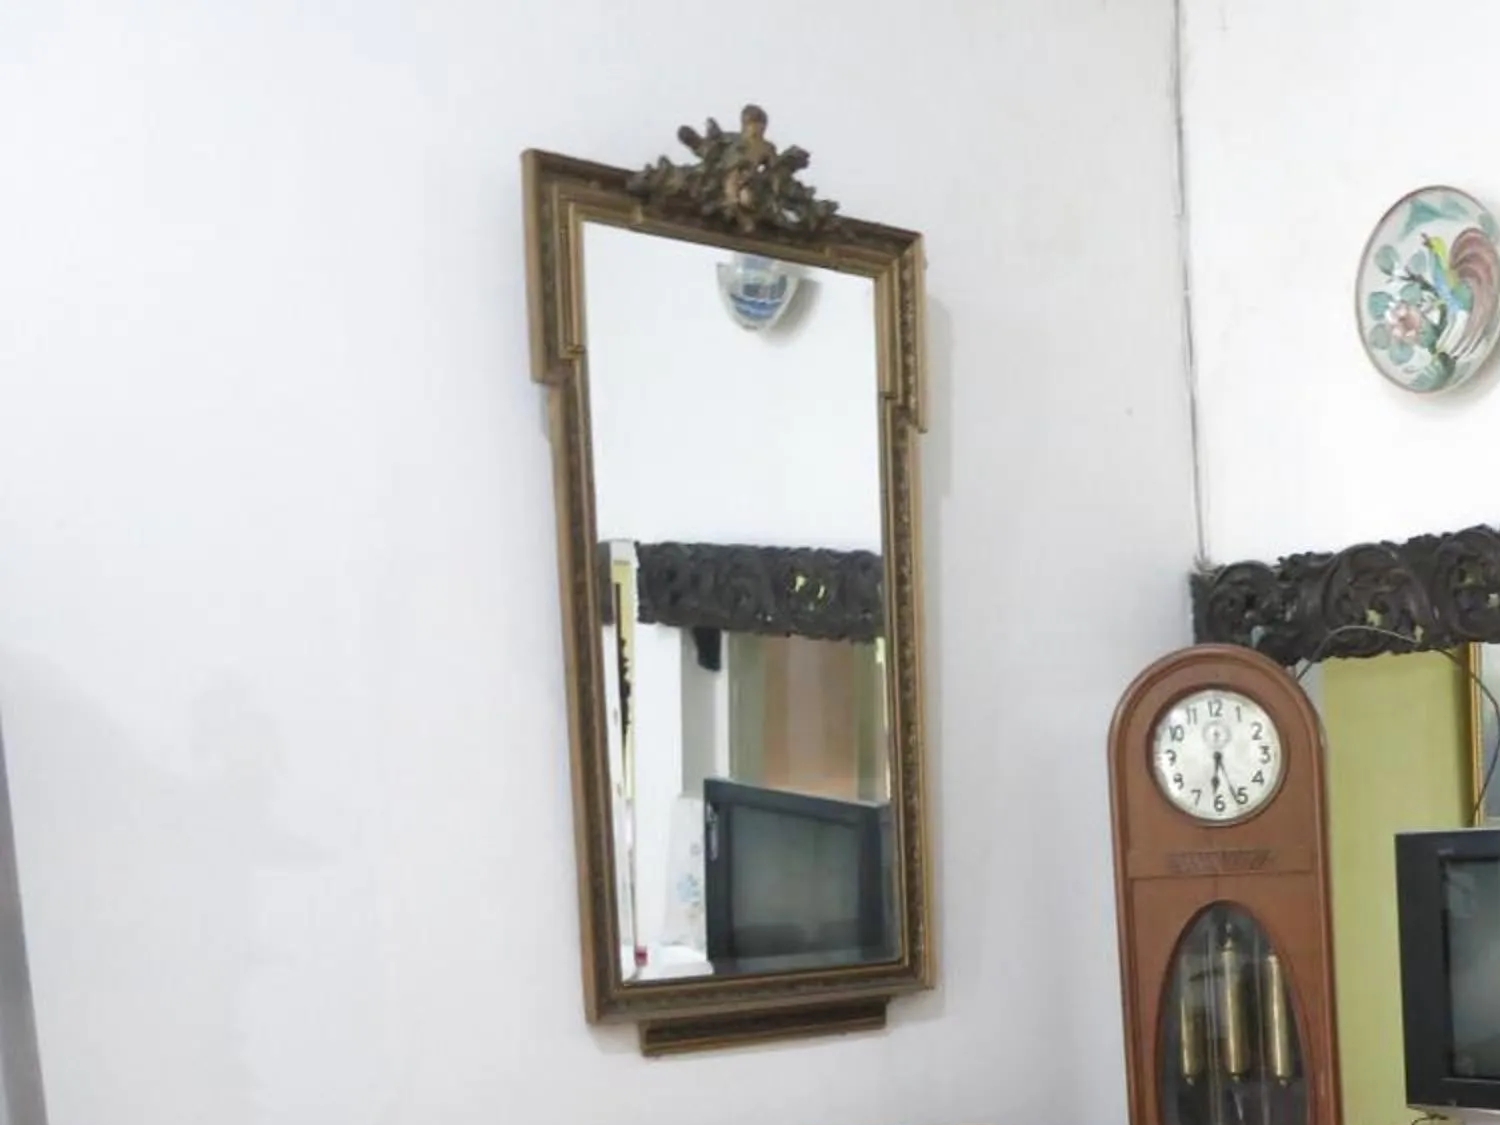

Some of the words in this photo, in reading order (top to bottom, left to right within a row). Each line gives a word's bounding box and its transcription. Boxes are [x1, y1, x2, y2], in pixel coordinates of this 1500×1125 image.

[1187, 707, 1197, 725] 11
[1208, 699, 1222, 717] 12
[1236, 705, 1241, 722] 1
[1169, 724, 1185, 742] 10
[1251, 722, 1262, 740] 2
[1260, 745, 1271, 764] 3
[1251, 770, 1265, 786] 4
[1191, 789, 1202, 805] 7
[1213, 794, 1226, 812] 6
[1236, 787, 1248, 805] 5
